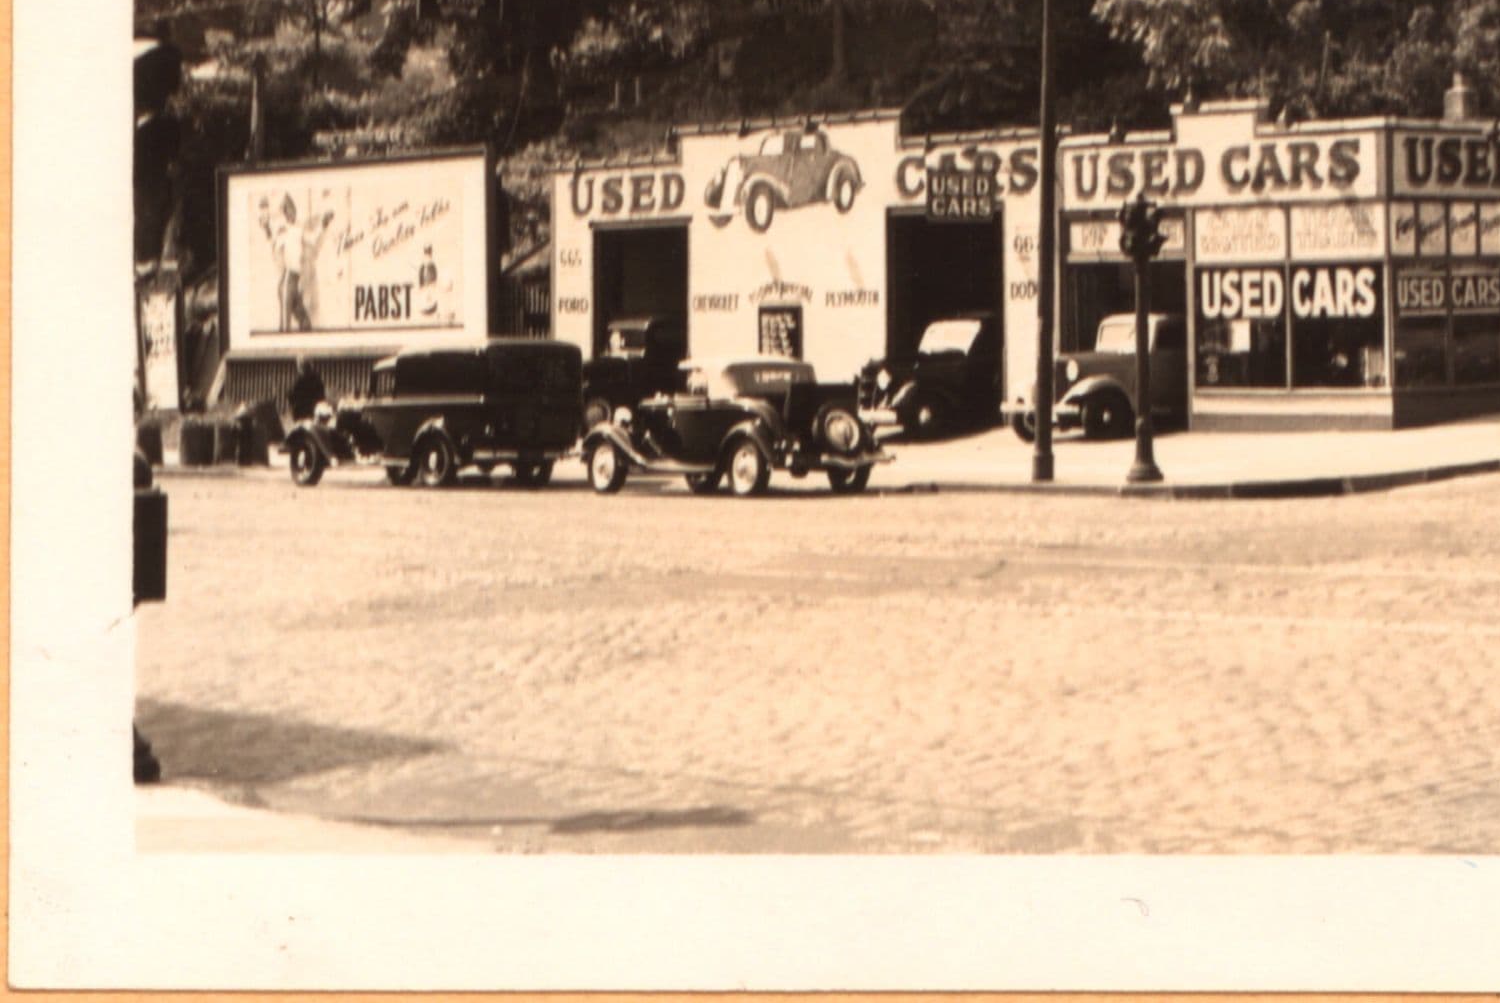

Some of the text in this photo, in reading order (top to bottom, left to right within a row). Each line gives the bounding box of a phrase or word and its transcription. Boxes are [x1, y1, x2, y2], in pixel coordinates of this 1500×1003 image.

[932, 175, 990, 194] USED
[1071, 138, 1360, 201] USED CARS
[568, 172, 686, 218] USED
[932, 198, 992, 216] CARS
[354, 282, 414, 322] PABST
[558, 297, 590, 314] FORD
[824, 290, 880, 307] PLYMOUTH
[1201, 267, 1377, 319] USED CARS
[1398, 276, 1500, 308] USED CARS
